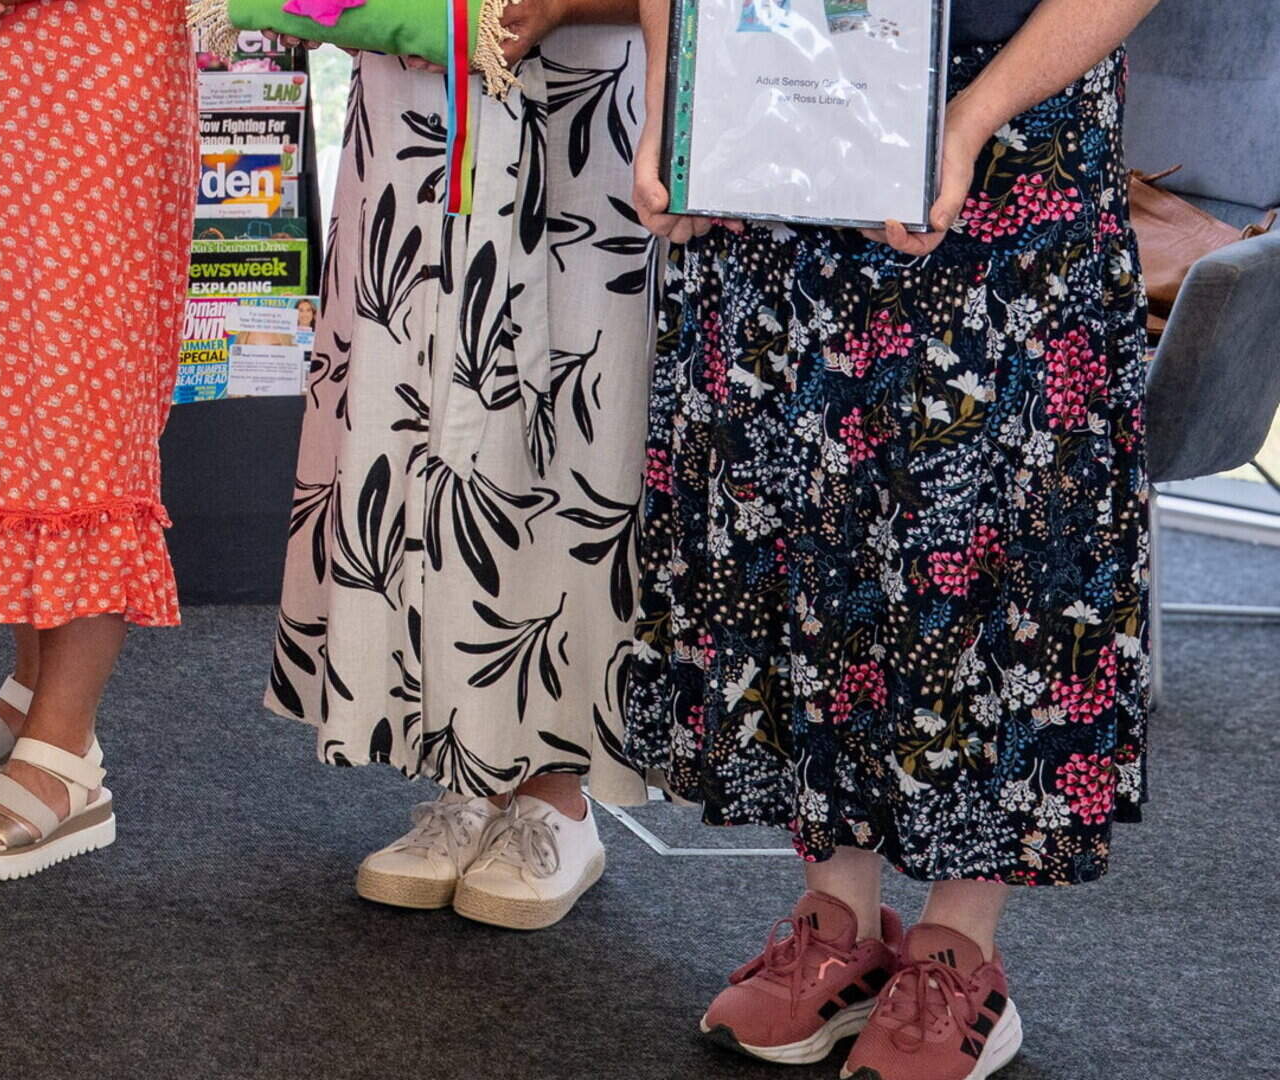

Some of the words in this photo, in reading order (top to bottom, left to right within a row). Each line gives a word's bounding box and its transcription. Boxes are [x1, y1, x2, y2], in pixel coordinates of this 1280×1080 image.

[756, 76, 779, 86] Adult
[782, 77, 819, 89] Sensory
[793, 95, 816, 104] Ross
[819, 96, 851, 107] Library
[223, 119, 266, 134] Fighting
[269, 120, 286, 132] For
[189, 257, 288, 277] ewsweek
[192, 281, 272, 293] EXPLORING
[182, 340, 224, 351] UMMER
